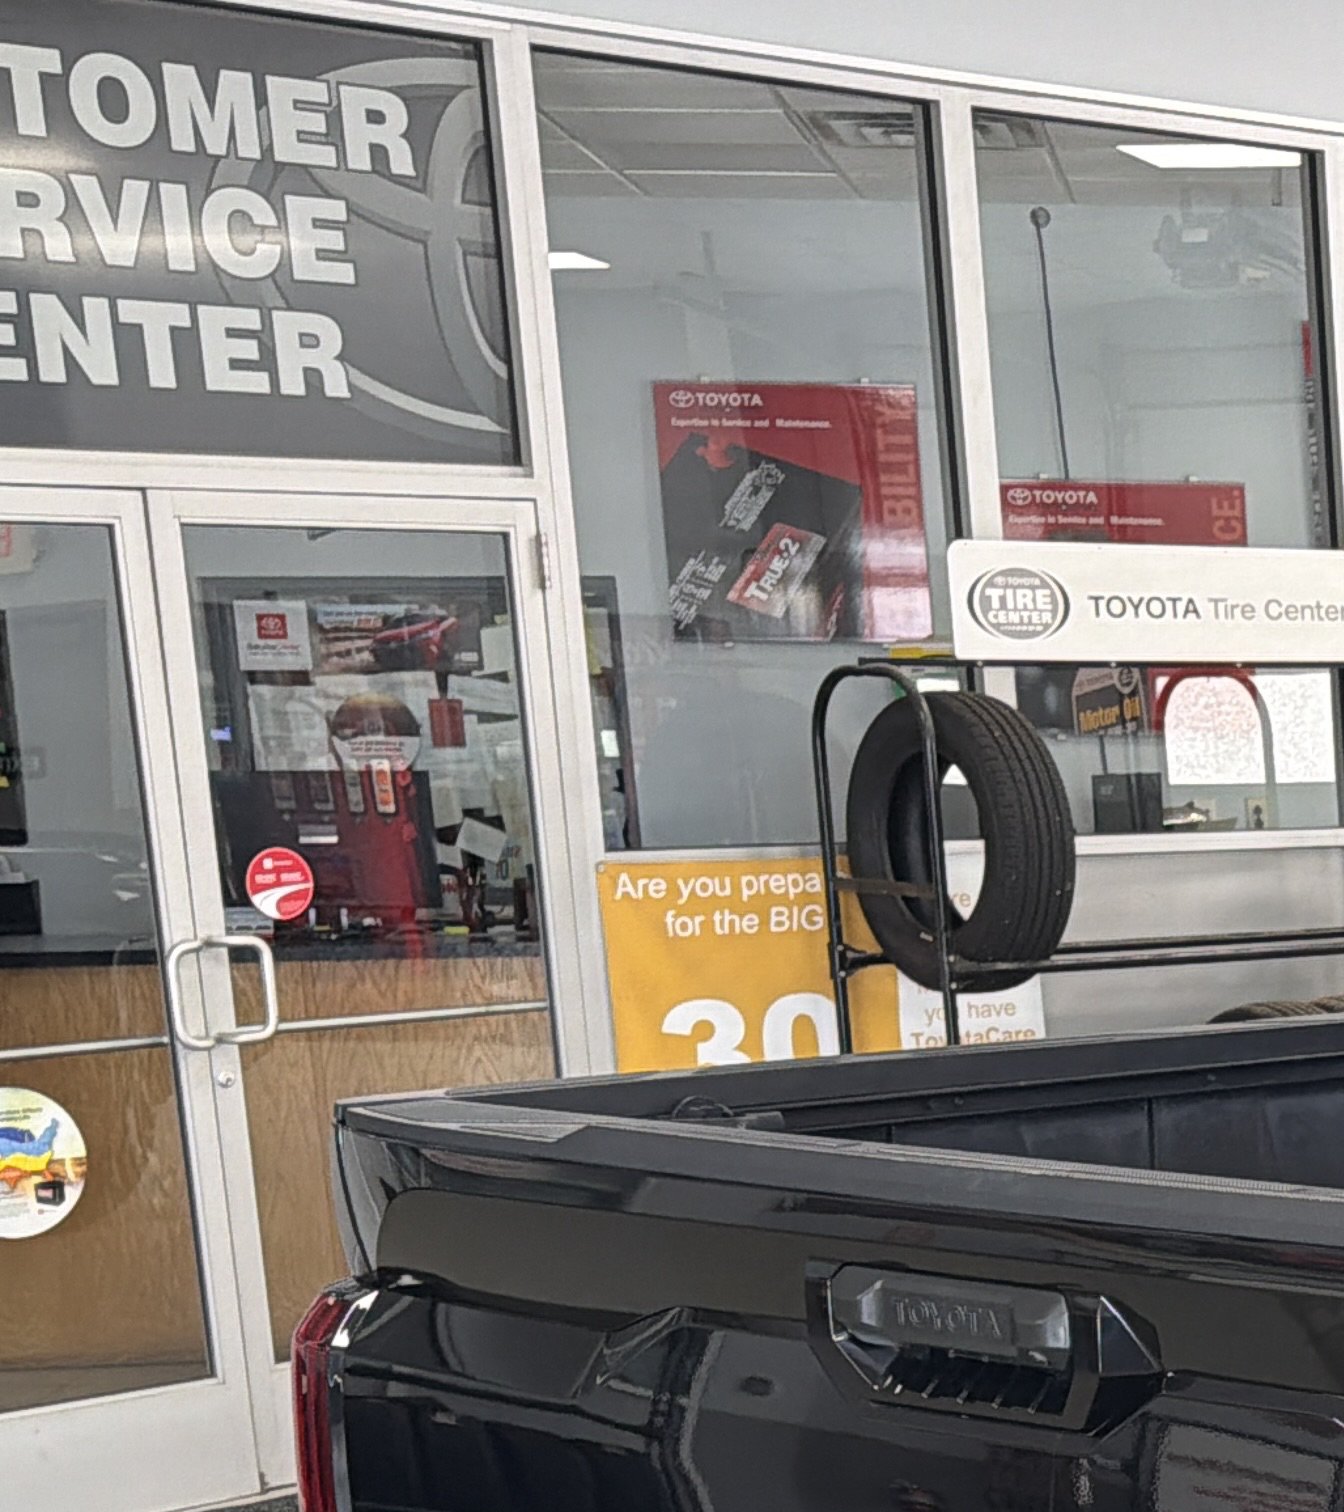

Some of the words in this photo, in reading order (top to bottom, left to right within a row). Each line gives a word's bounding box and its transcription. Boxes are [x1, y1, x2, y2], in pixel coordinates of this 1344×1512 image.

[0, 43, 416, 177] TOMER
[0, 168, 357, 285] RVICE
[696, 392, 764, 407] TOYOTA
[722, 418, 751, 427] Service
[754, 418, 769, 428] and
[1032, 490, 1099, 505] TOYOTA
[1089, 515, 1104, 525] and
[1007, 577, 1041, 586] TOYOTA
[985, 588, 1053, 610] TIRE
[1088, 595, 1202, 620] TOYOTA
[1207, 597, 1257, 621] Tire
[987, 610, 1053, 624] CENTER
[1079, 704, 1120, 733] Motor
[615, 872, 668, 899] Are
[676, 875, 731, 906] you
[741, 871, 821, 901] prepa
[664, 909, 705, 937] for
[713, 908, 760, 935] the
[769, 905, 825, 934] BIG
[967, 1001, 1017, 1019] have
